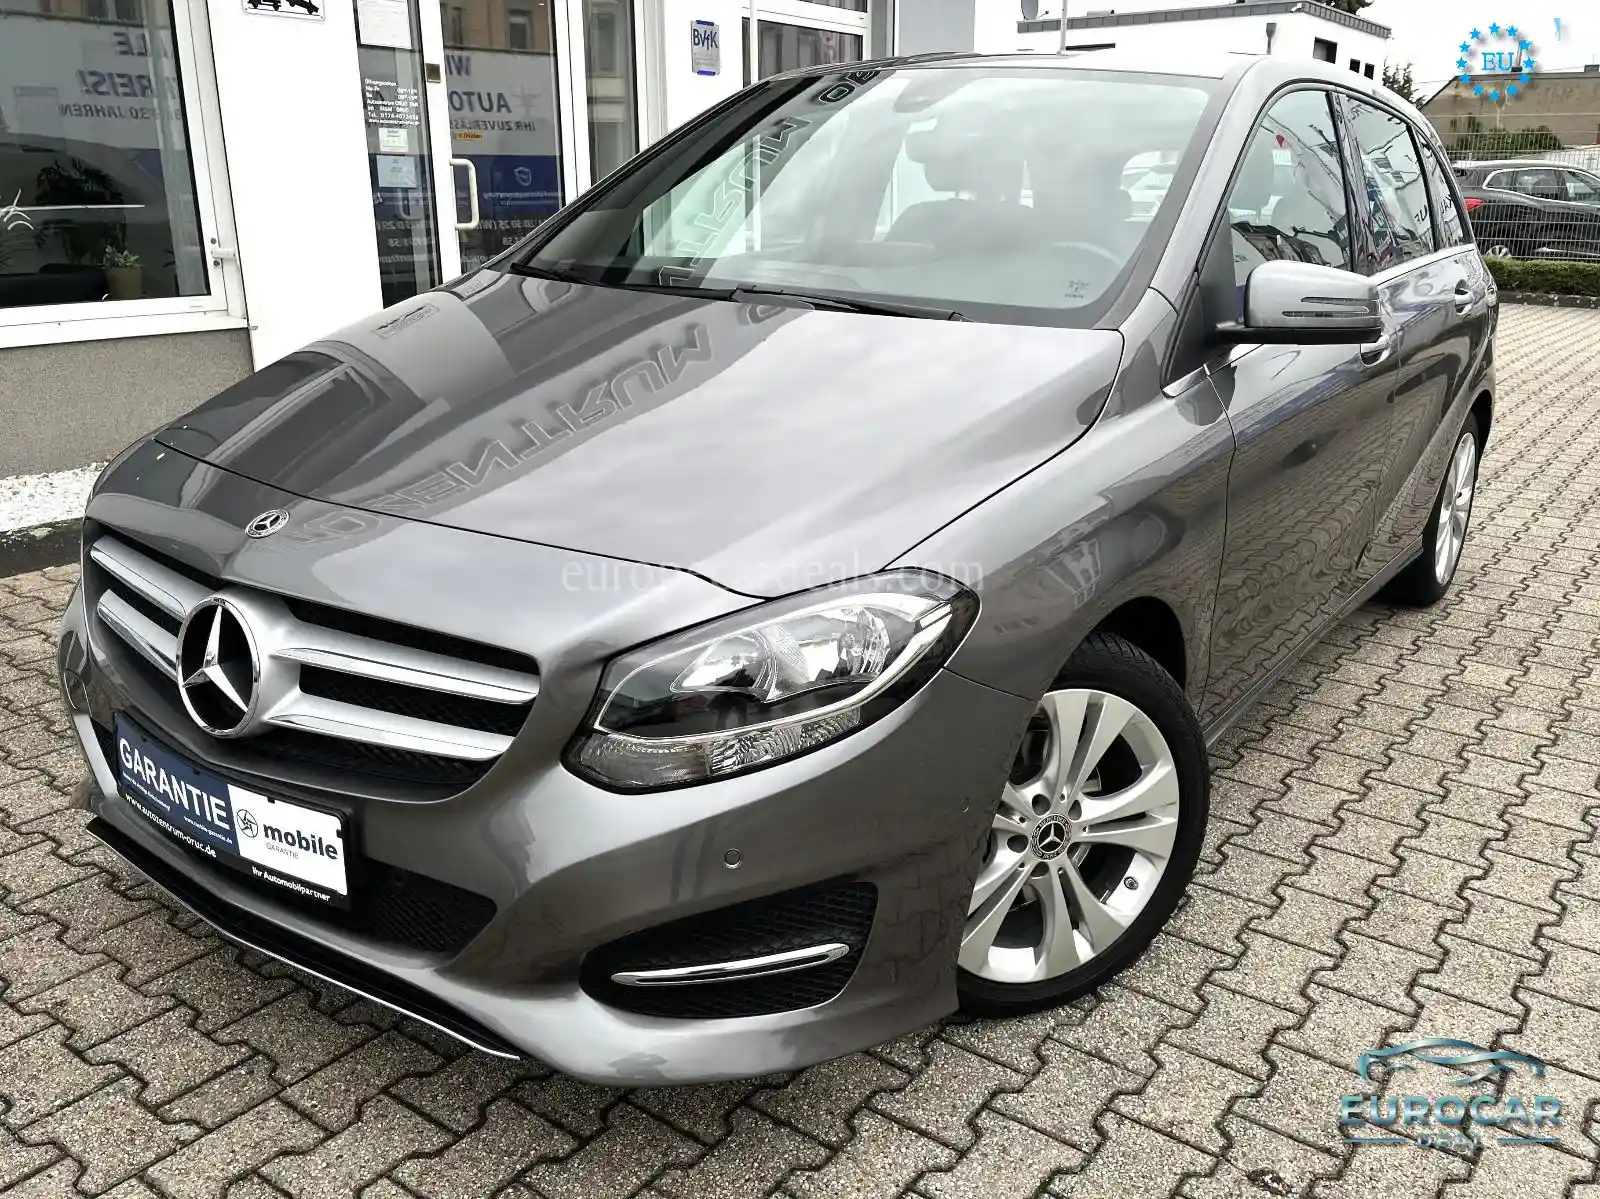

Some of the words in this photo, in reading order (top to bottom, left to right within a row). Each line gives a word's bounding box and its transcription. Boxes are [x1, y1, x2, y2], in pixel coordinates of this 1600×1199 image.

[120, 737, 231, 831] GARANTIE
[125, 793, 217, 858] www.autozentrum-oruc.de
[263, 823, 339, 860] mobile
[266, 842, 299, 859] GARANTIE
[252, 866, 262, 877] Ihr
[263, 871, 331, 902] Automobilpartner
